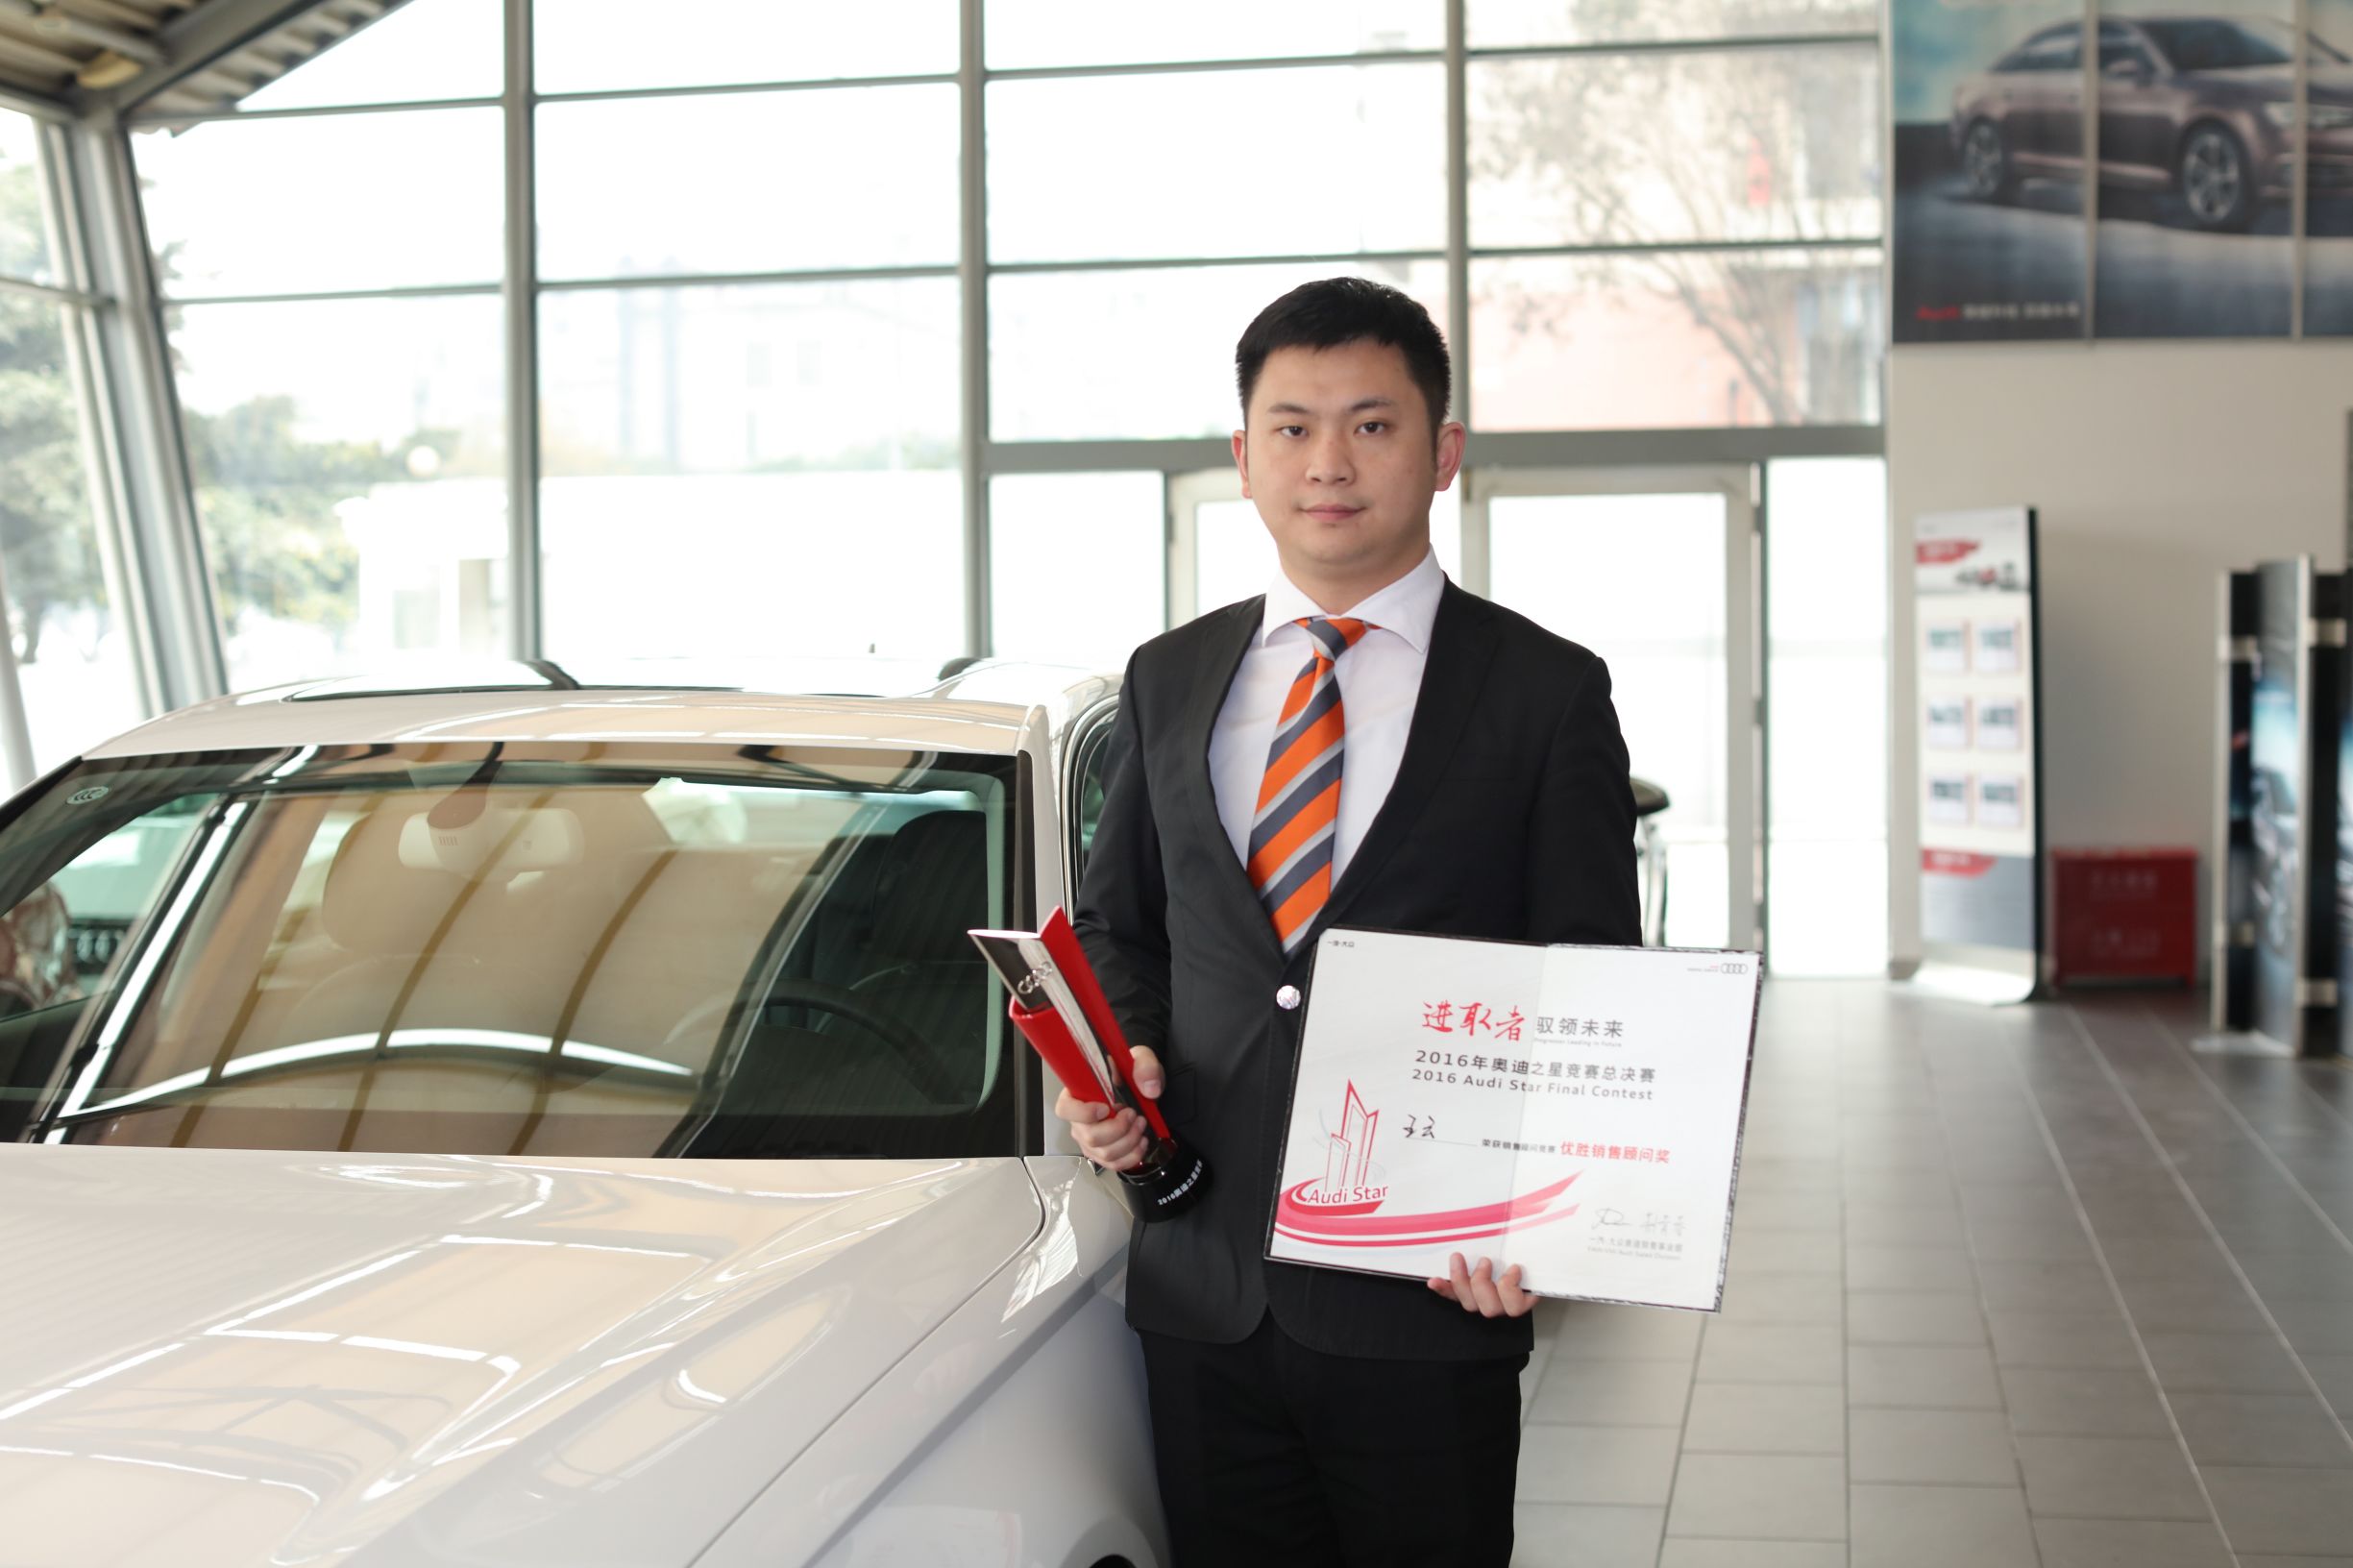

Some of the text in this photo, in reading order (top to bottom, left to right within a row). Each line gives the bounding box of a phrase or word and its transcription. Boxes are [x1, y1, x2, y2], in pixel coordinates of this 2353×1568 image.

[1422, 1000, 1525, 1041] 进取者
[1537, 1017, 1624, 1038] 驭领未来
[1415, 1049, 1656, 1083] 2016年奥迪之星竞赛总决赛
[1411, 1068, 1654, 1100] 2016 Audi Star Final Contest
[1560, 1141, 1671, 1164] 优胜销售顾问奖
[1307, 1186, 1389, 1204] Audi Star
